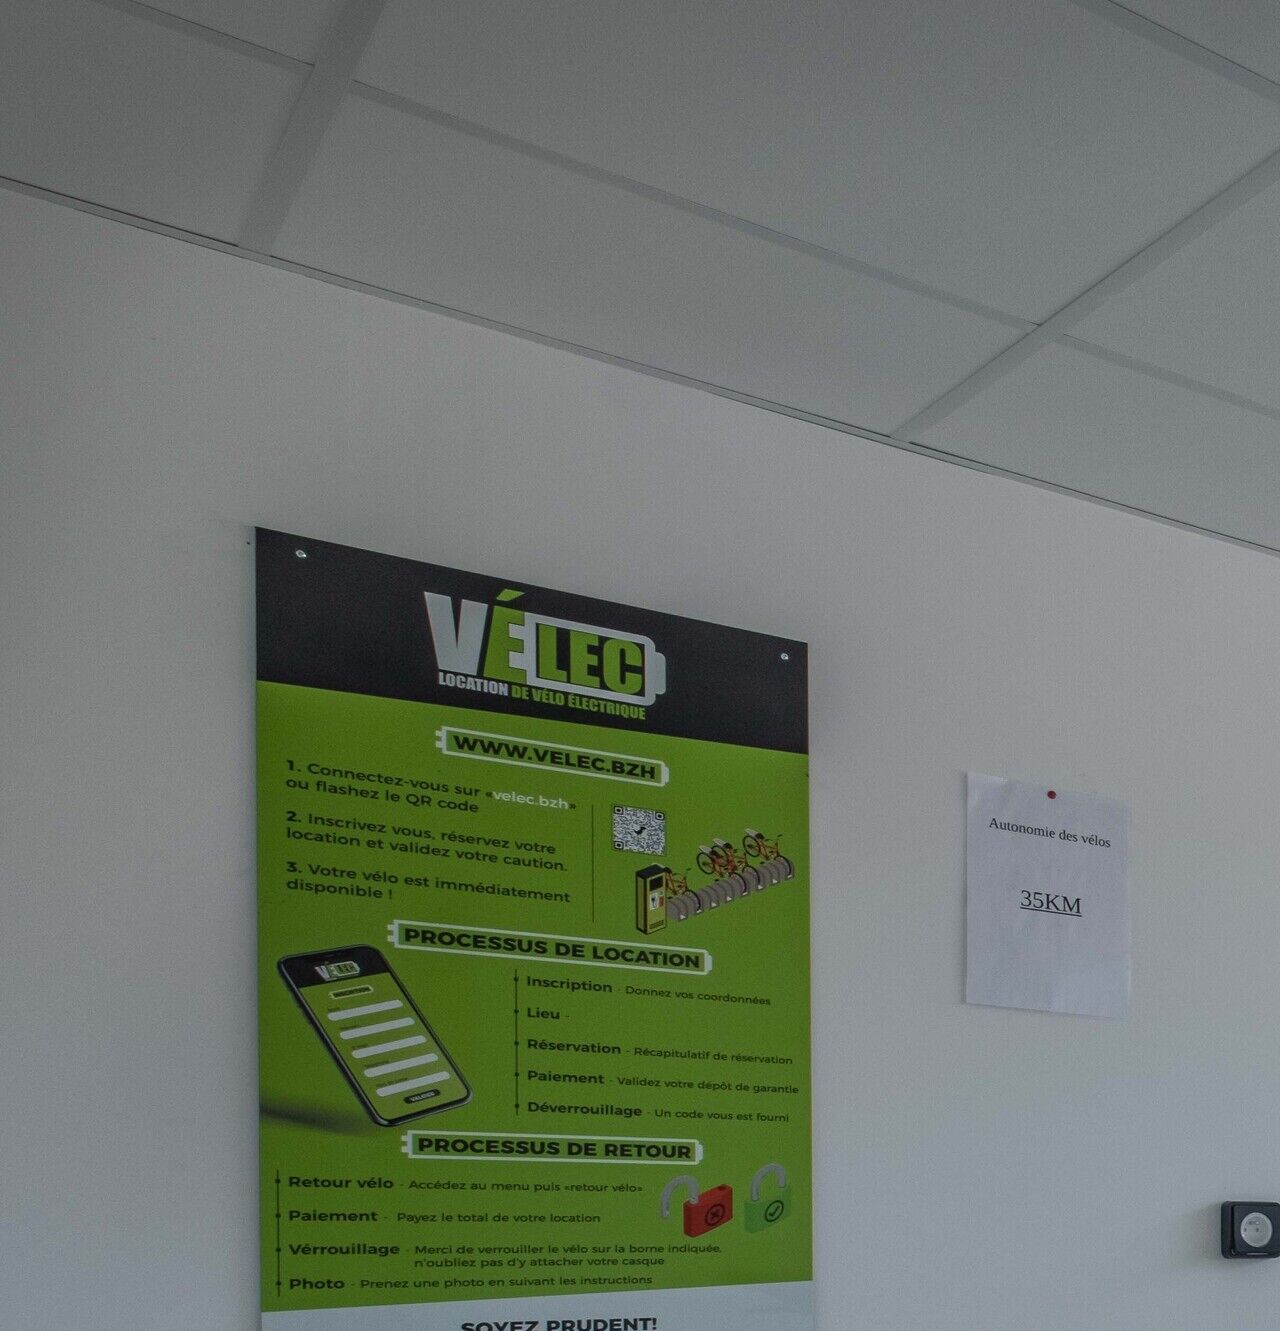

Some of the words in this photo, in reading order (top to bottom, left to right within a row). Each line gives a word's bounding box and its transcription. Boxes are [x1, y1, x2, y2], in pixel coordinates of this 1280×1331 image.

[424, 588, 645, 695] VÉLEC
[438, 672, 509, 697] LOCATION
[511, 684, 530, 699] DE
[532, 686, 566, 707] VÉLO
[568, 694, 646, 720] ÉLECTRIQUE
[453, 735, 656, 779] WWW.VELEC.BZH
[286, 759, 301, 773] 1.
[306, 762, 450, 793] Connectez-vous
[453, 784, 481, 797] sur
[286, 777, 310, 790] ou
[315, 779, 380, 801] flashez
[384, 789, 401, 802] le
[405, 792, 433, 808] QR
[437, 798, 480, 814] code
[286, 810, 300, 824] 2.
[308, 812, 388, 835] Inscrivez
[440, 829, 510, 849] réservez
[515, 839, 557, 854] votre
[988, 817, 1056, 839] Autonomie
[1058, 829, 1078, 843] des
[1081, 834, 1112, 848] vélos
[286, 827, 361, 848] location
[366, 836, 385, 849] et
[389, 838, 450, 858] validez
[455, 849, 499, 863] votre
[503, 854, 568, 872] caution.
[286, 860, 302, 874] 3.
[307, 864, 357, 880] Votre
[362, 864, 399, 885] vélo
[403, 875, 430, 888] est
[435, 876, 572, 903] immédiatement
[286, 876, 384, 900] disponible
[1020, 889, 1082, 915] 35KM
[403, 927, 549, 955] PROCESSUS
[554, 941, 586, 959] DE
[592, 945, 701, 969] LOCATION
[526, 975, 613, 994] Inscription
[625, 985, 672, 999] Donnez
[674, 990, 694, 1000] vos
[697, 992, 772, 1006] coordonnées
[526, 1007, 561, 1020] Lieu
[527, 1038, 622, 1056] Réservation
[633, 1045, 711, 1062] Récapitulatif
[712, 1051, 729, 1062] de
[731, 1052, 794, 1065] réservation
[527, 1069, 605, 1085] Paiement
[616, 1075, 662, 1088] Validez
[664, 1079, 695, 1090] votre
[697, 1078, 732, 1094] dépôt
[735, 1081, 751, 1092] de
[753, 1082, 799, 1097] garantie
[527, 1101, 643, 1120] Déverrouillage
[654, 1108, 672, 1119] Un
[674, 1109, 704, 1120] code
[707, 1111, 734, 1121] vous
[736, 1111, 752, 1122] est
[755, 1110, 790, 1123] fourni
[417, 1137, 561, 1156] PROCESSUS
[566, 1141, 598, 1157] DE
[603, 1143, 692, 1160] RETOUR
[287, 1175, 352, 1190] Retour
[356, 1175, 394, 1190] vélo
[408, 1178, 467, 1192] Accédez
[469, 1181, 487, 1192] au
[491, 1182, 530, 1192] menu
[533, 1181, 561, 1194] puis
[287, 1208, 379, 1223] Paiement
[396, 1212, 438, 1225] Payez
[440, 1212, 454, 1223] le
[457, 1212, 489, 1223] total
[491, 1212, 510, 1223] de
[512, 1213, 547, 1224] votre
[550, 1212, 601, 1224] location
[287, 1242, 401, 1257] Vérrouillage
[414, 1244, 453, 1255] Merci
[456, 1244, 475, 1255] de
[477, 1244, 545, 1255] verrouiller
[547, 1244, 560, 1255] le
[562, 1243, 589, 1254] vélo
[591, 1245, 613, 1254] sur
[615, 1244, 626, 1254] la
[629, 1244, 665, 1254] borne
[413, 1257, 477, 1269] n'oubliez
[480, 1258, 505, 1270] pas
[507, 1256, 526, 1270] d'y
[530, 1256, 585, 1267] attacher
[587, 1256, 619, 1267] votre
[621, 1256, 666, 1269] casque
[288, 1277, 346, 1290] Photo
[360, 1278, 409, 1289] Prenez
[413, 1279, 440, 1289] une
[443, 1277, 486, 1290] photo
[488, 1278, 506, 1288] en
[508, 1276, 556, 1288] suivant
[559, 1275, 577, 1286] les
[580, 1274, 653, 1286] instructions
